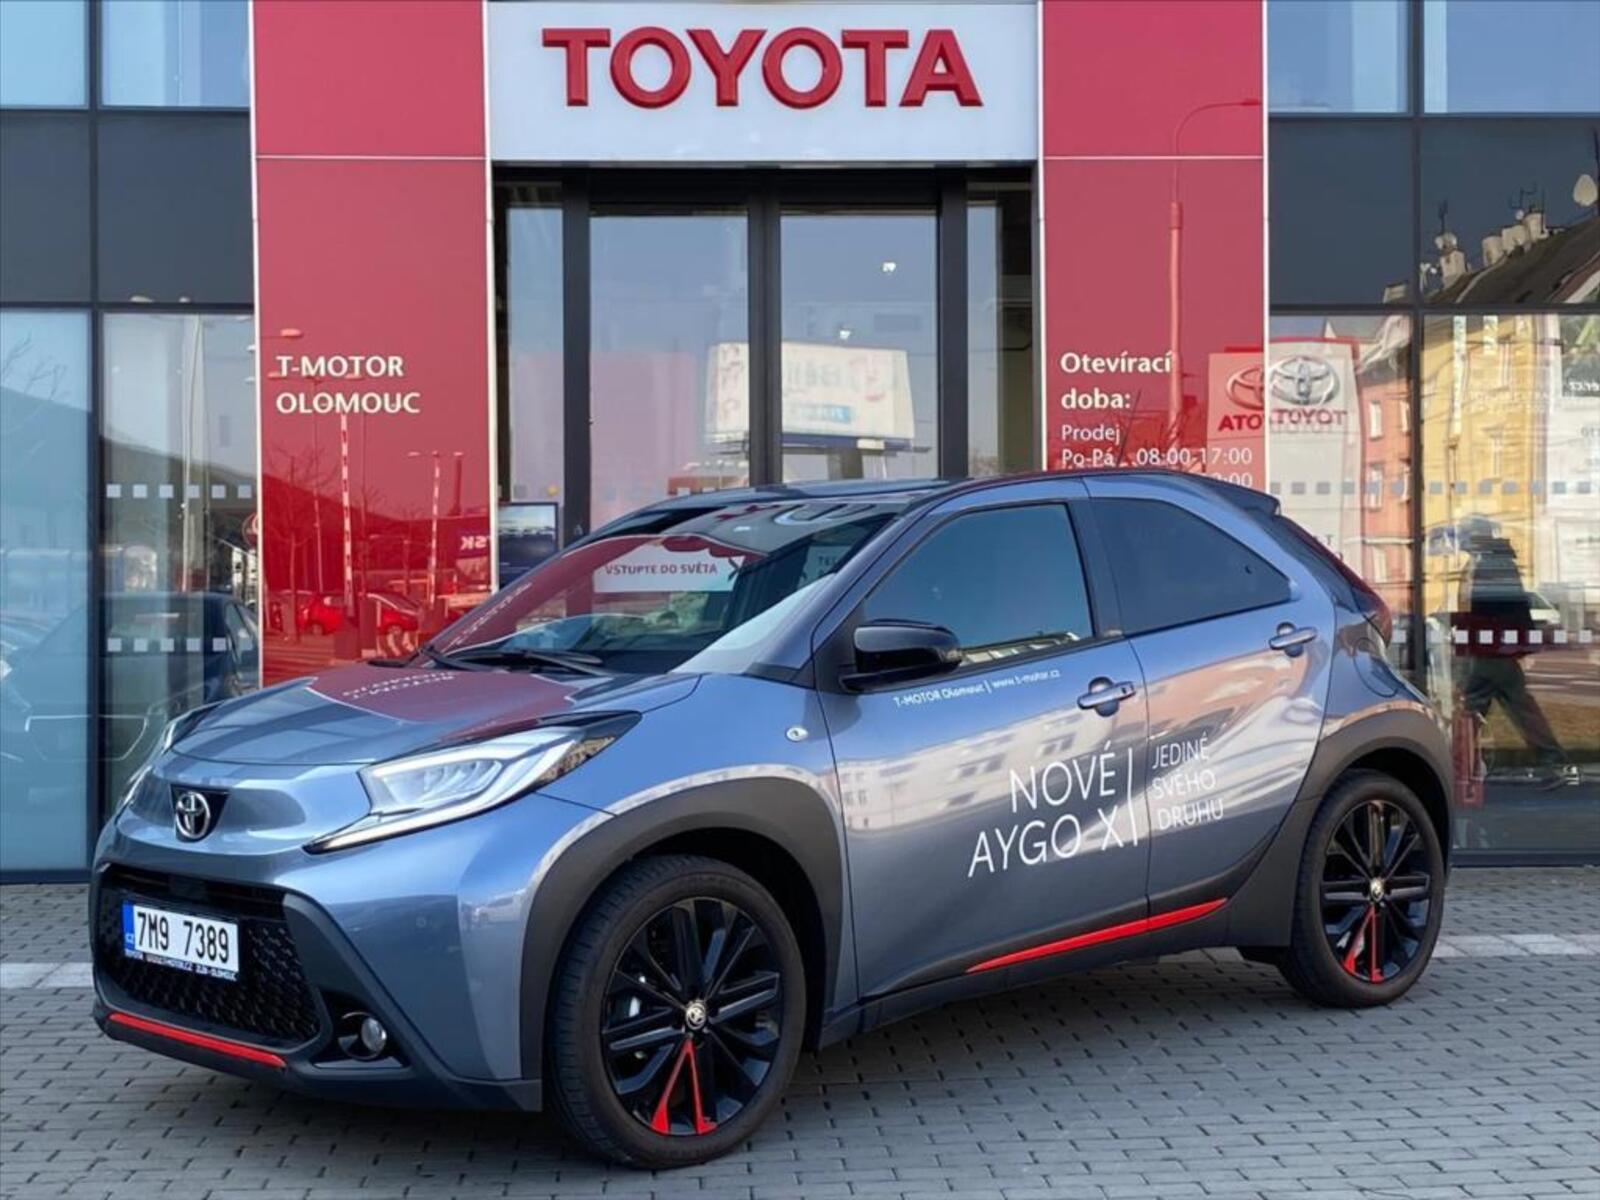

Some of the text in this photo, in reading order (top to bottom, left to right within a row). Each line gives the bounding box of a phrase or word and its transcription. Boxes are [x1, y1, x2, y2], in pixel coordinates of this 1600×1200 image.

[542, 27, 984, 109] TOYOTA
[275, 355, 405, 378] T-MOTOR
[1060, 351, 1174, 374] Otevírací
[275, 391, 421, 415] OLOMOUC
[1060, 387, 1132, 411] doba:
[1061, 424, 1121, 446] Prodej
[1152, 730, 1209, 769] JEDINÉ
[1009, 740, 1116, 814] NOVÉ
[1158, 799, 1223, 830] DRUHU
[967, 804, 1125, 878] AYGO X
[136, 911, 229, 964] 7M9 7389
